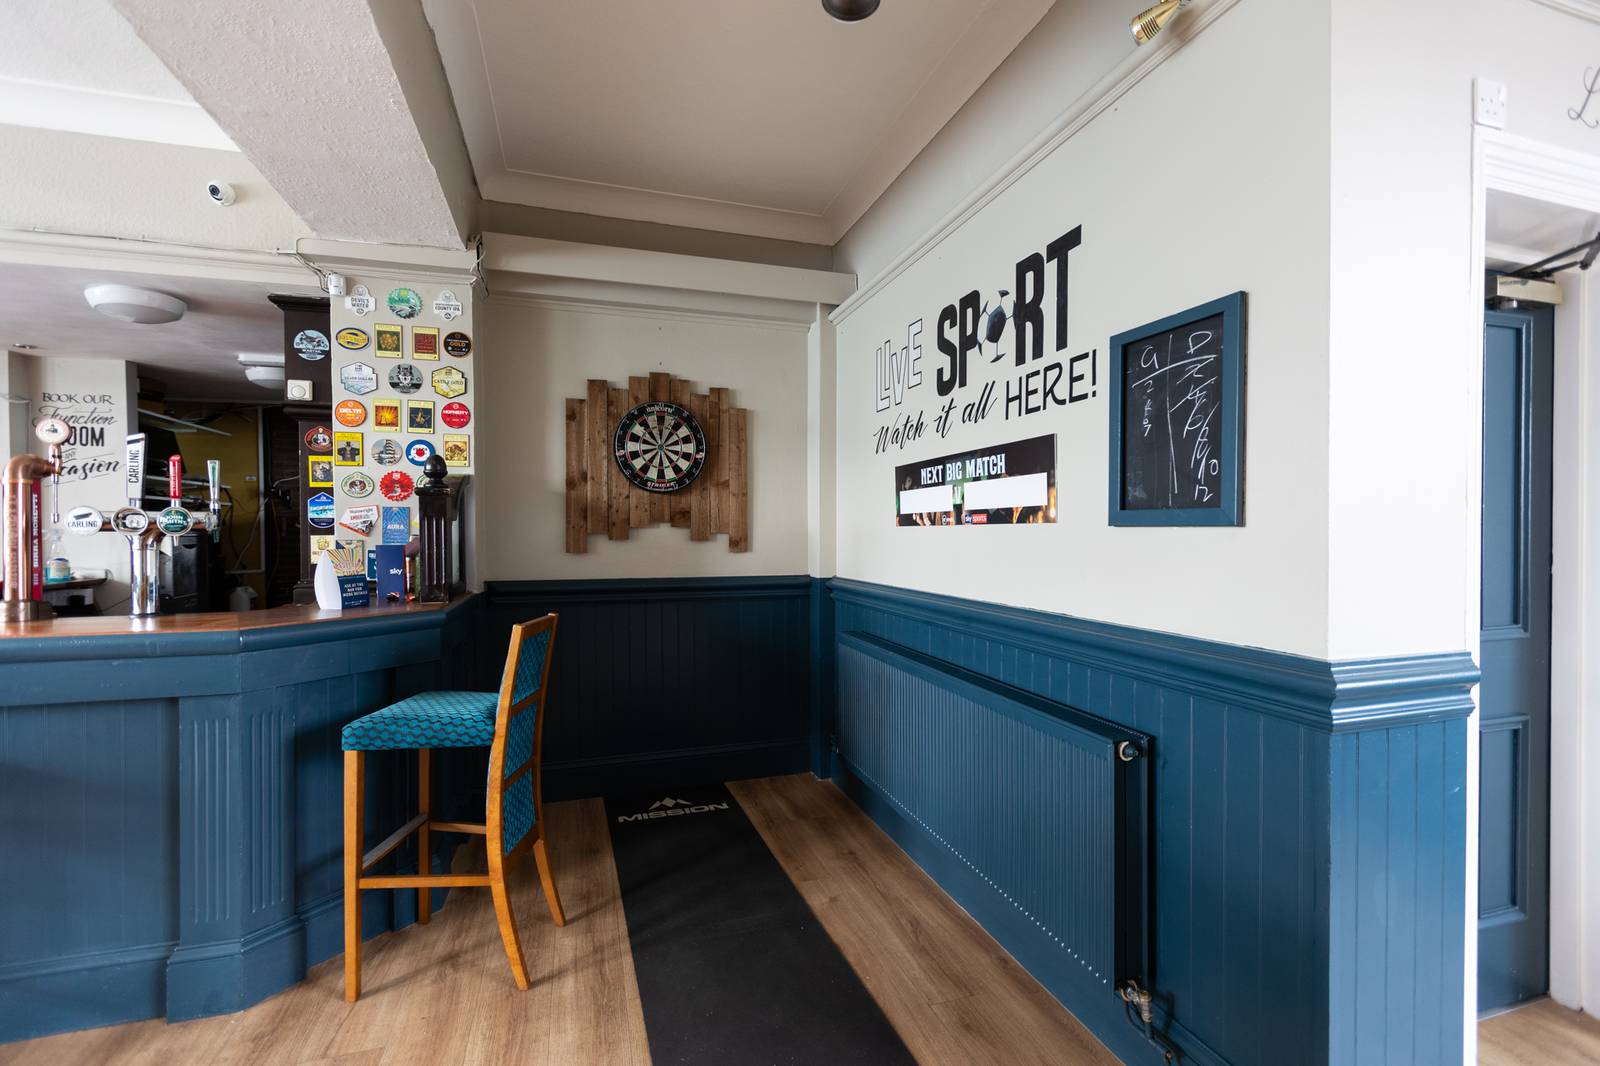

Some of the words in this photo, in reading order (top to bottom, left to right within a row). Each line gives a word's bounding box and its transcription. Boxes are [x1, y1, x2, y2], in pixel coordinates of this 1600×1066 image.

[875, 318, 923, 413] LIVE
[42, 392, 80, 404] BOOK
[82, 394, 115, 405] OUR
[873, 411, 928, 455] Watch
[934, 397, 957, 438] it
[962, 380, 998, 424] all
[1005, 349, 1097, 420] HERE!
[62, 426, 105, 447] OOM
[128, 449, 140, 484] CARLING
[920, 465, 943, 485] NEXT
[945, 461, 963, 481] BIG
[965, 453, 1006, 478] MATCH
[1195, 484, 1214, 502] 12
[67, 520, 98, 528] CARLING
[389, 568, 403, 576] sky
[617, 802, 729, 823] MISSION
